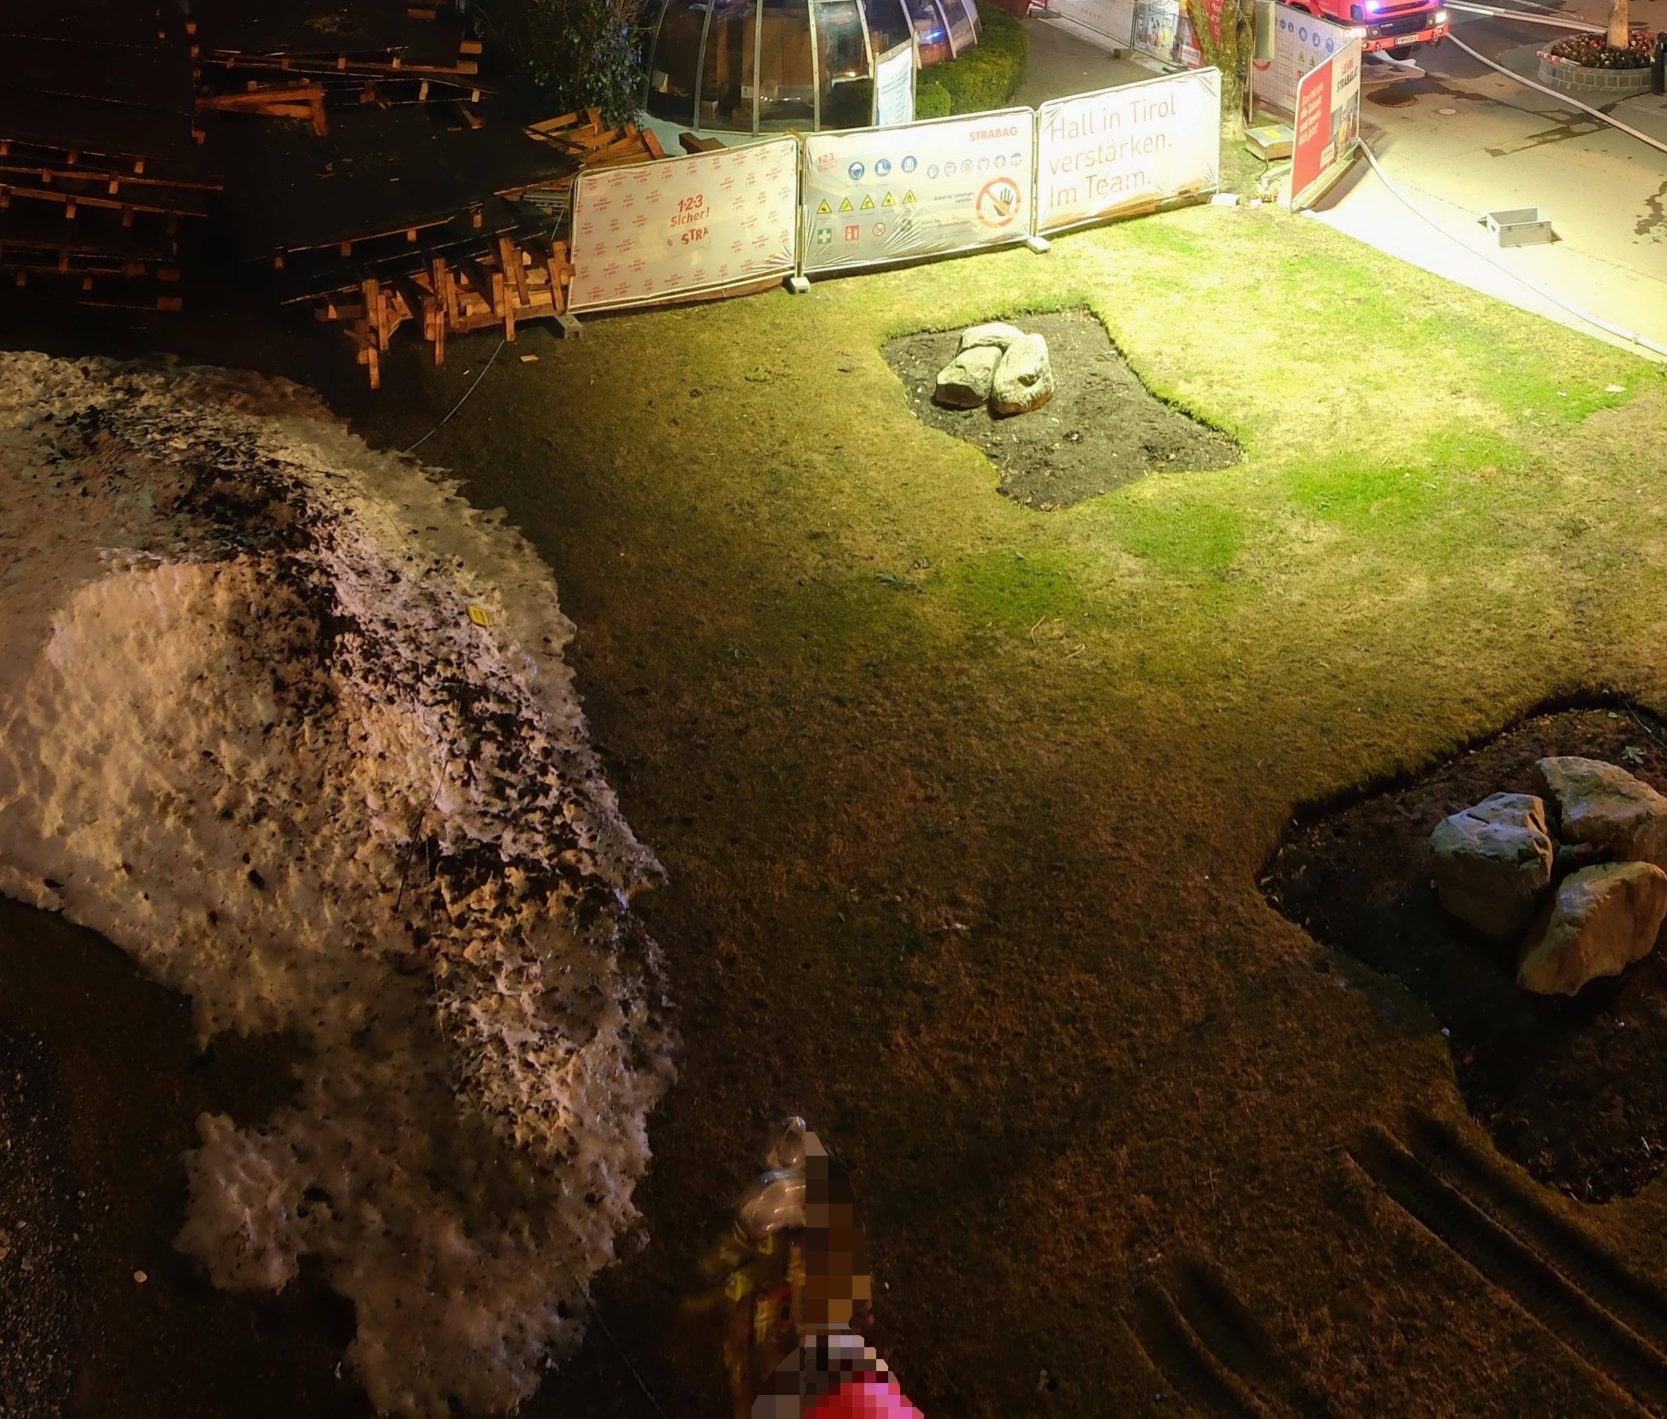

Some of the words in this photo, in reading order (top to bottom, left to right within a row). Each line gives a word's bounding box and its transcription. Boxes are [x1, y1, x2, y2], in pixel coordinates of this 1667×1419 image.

[969, 127, 1018, 141] STRABAG
[1050, 112, 1095, 142] Hall
[1103, 108, 1121, 130] in
[1129, 93, 1176, 124] Tirol
[1049, 132, 1172, 175] verstärken.
[1050, 185, 1077, 208] Im
[1086, 171, 1151, 199] Team.
[670, 207, 711, 227] Sicher!
